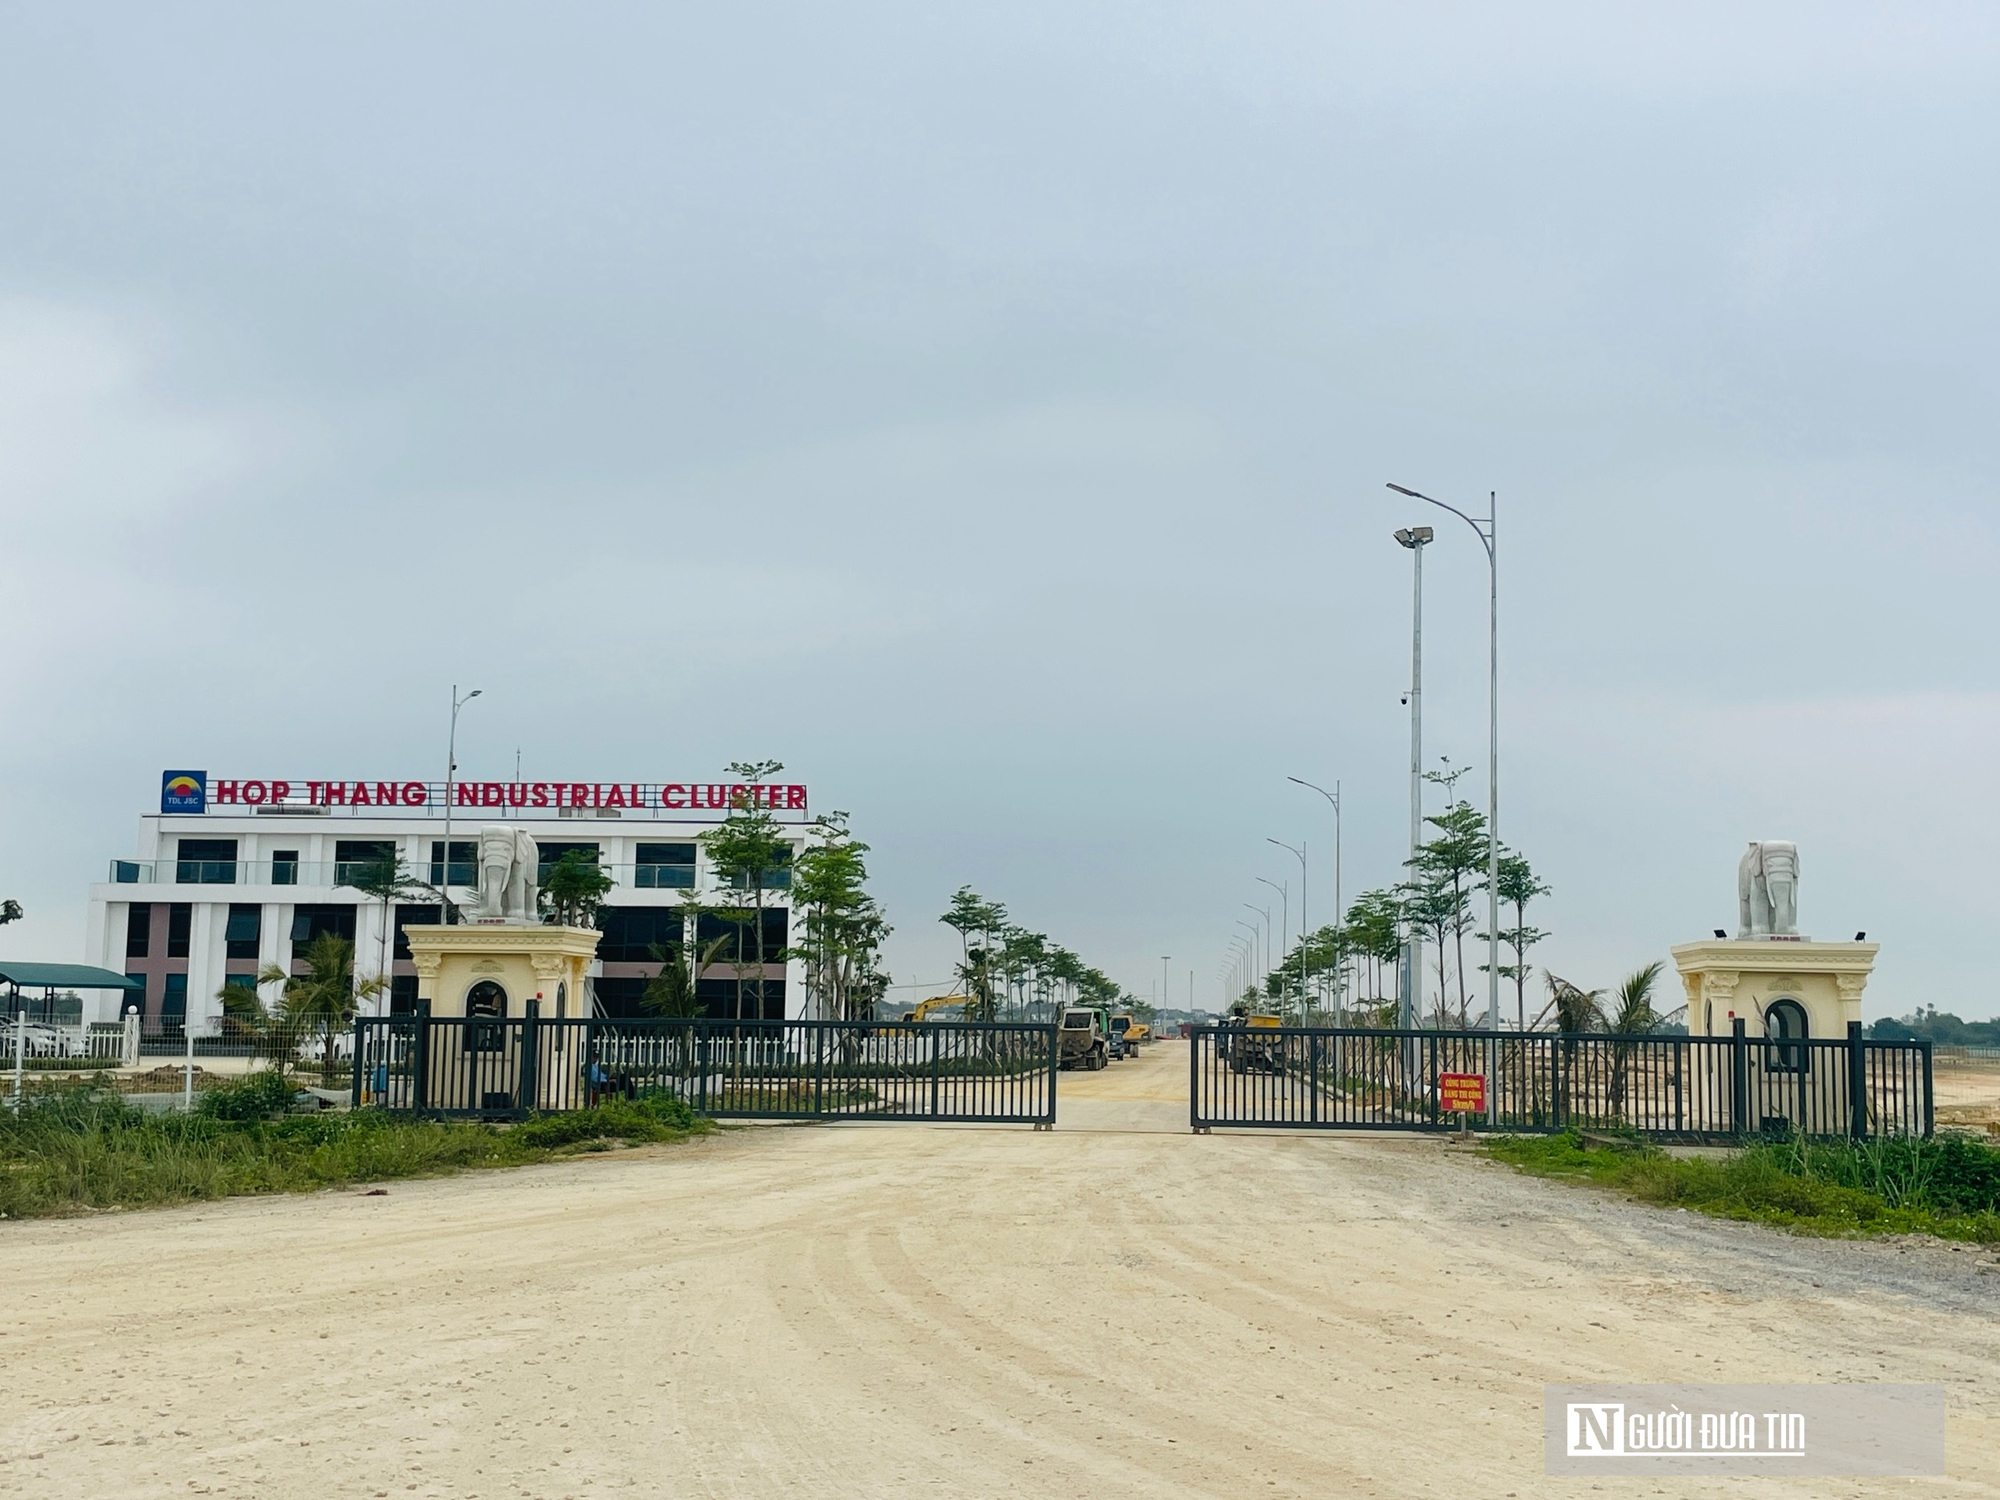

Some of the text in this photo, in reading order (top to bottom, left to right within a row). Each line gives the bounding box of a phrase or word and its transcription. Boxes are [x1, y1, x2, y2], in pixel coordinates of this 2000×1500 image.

[217, 781, 289, 804] HOP
[306, 782, 427, 806] THANG
[662, 784, 805, 809] CLUSTER
